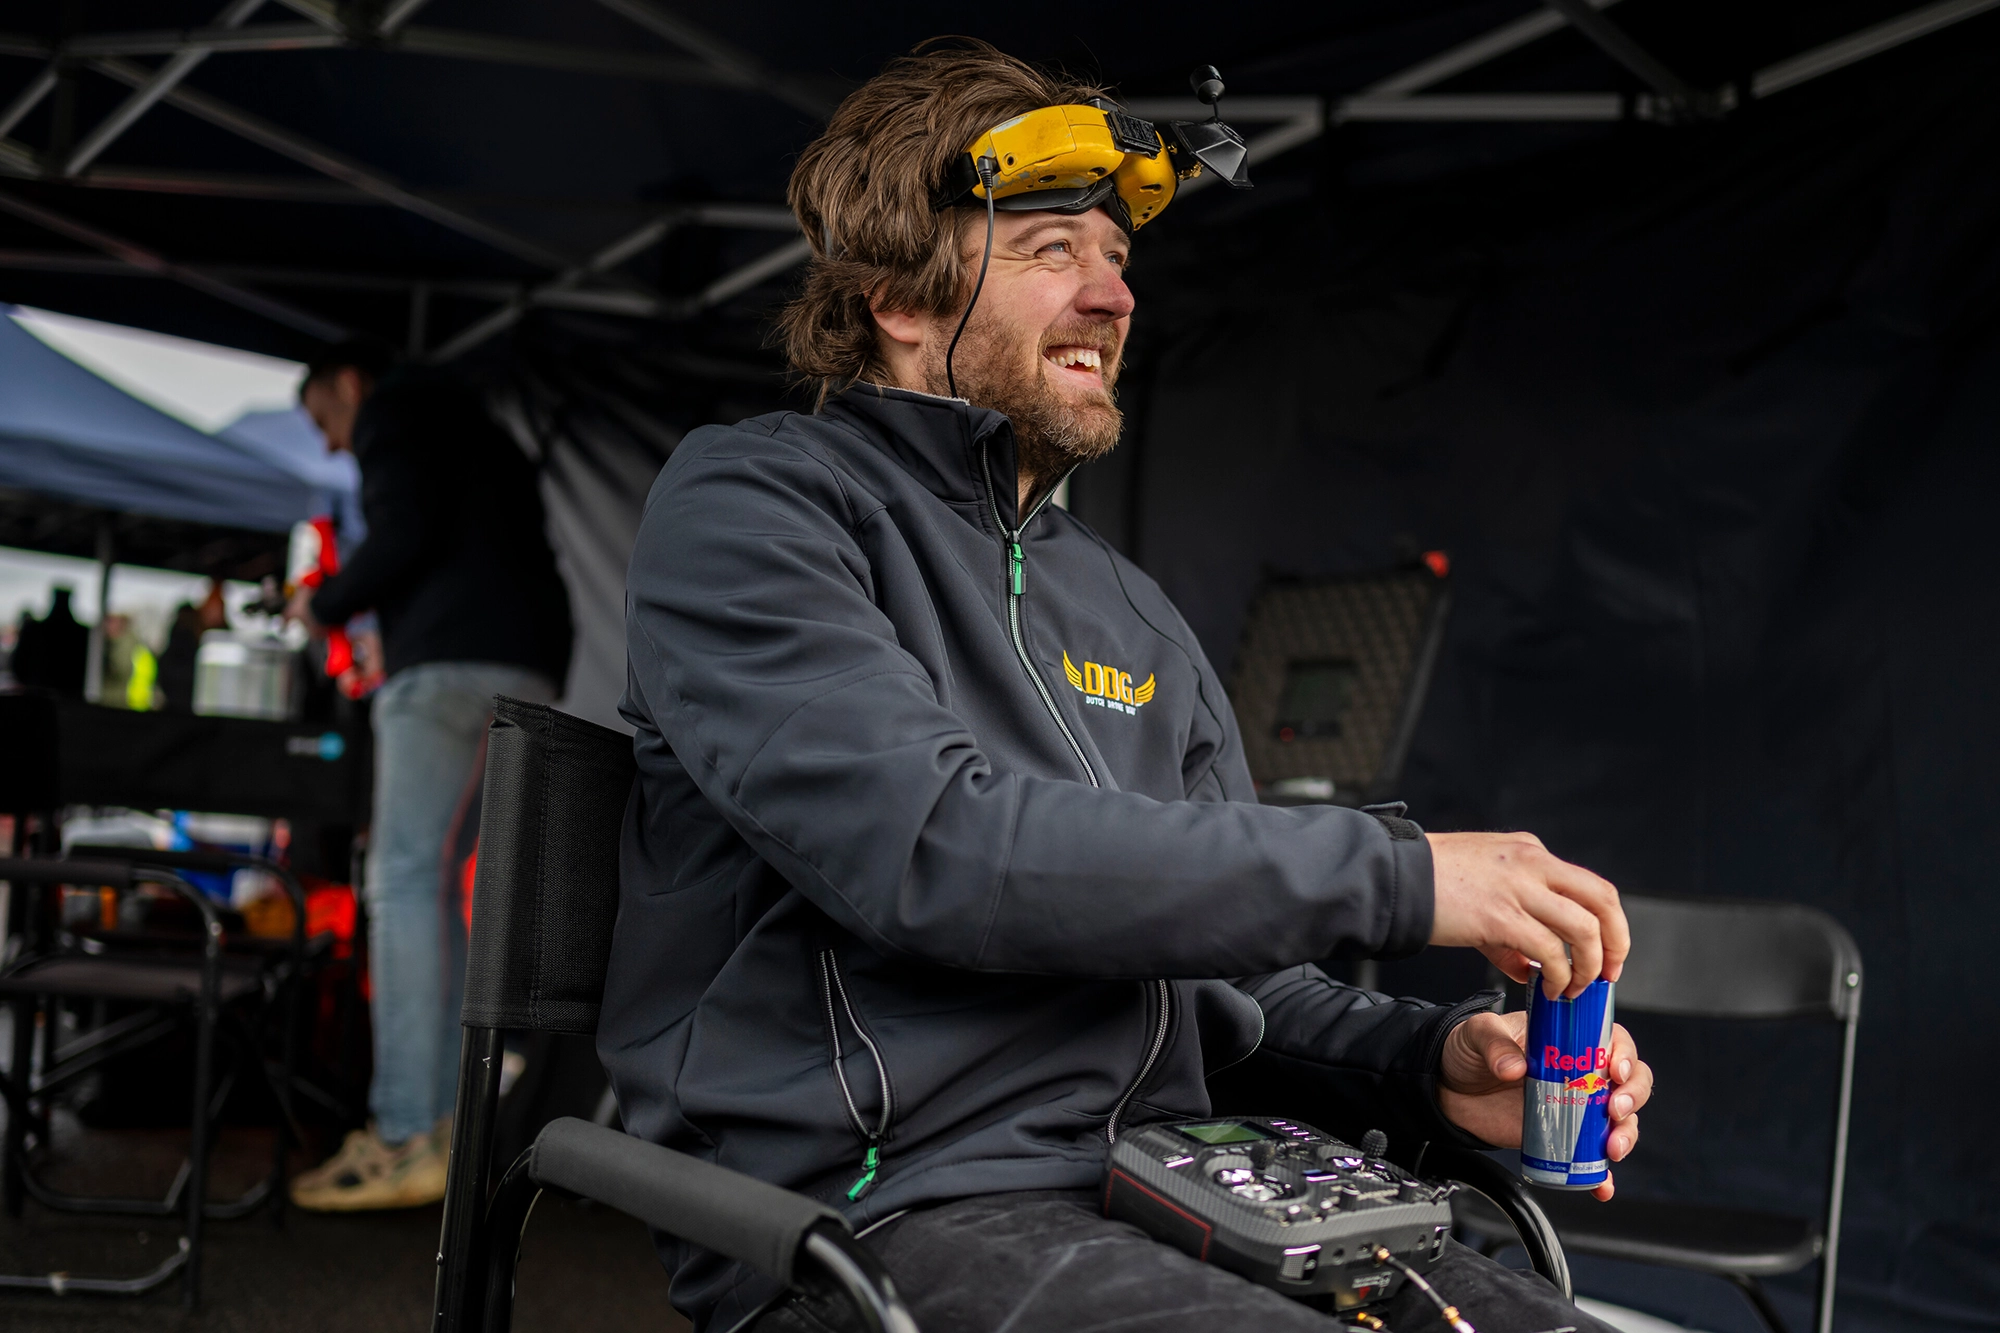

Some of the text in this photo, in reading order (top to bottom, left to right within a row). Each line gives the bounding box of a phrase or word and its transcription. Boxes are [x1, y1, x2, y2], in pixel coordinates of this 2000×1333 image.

[1084, 661, 1133, 705] DDG
[1544, 1045, 1609, 1071] Red B
[1545, 1094, 1593, 1106] ENERGY
